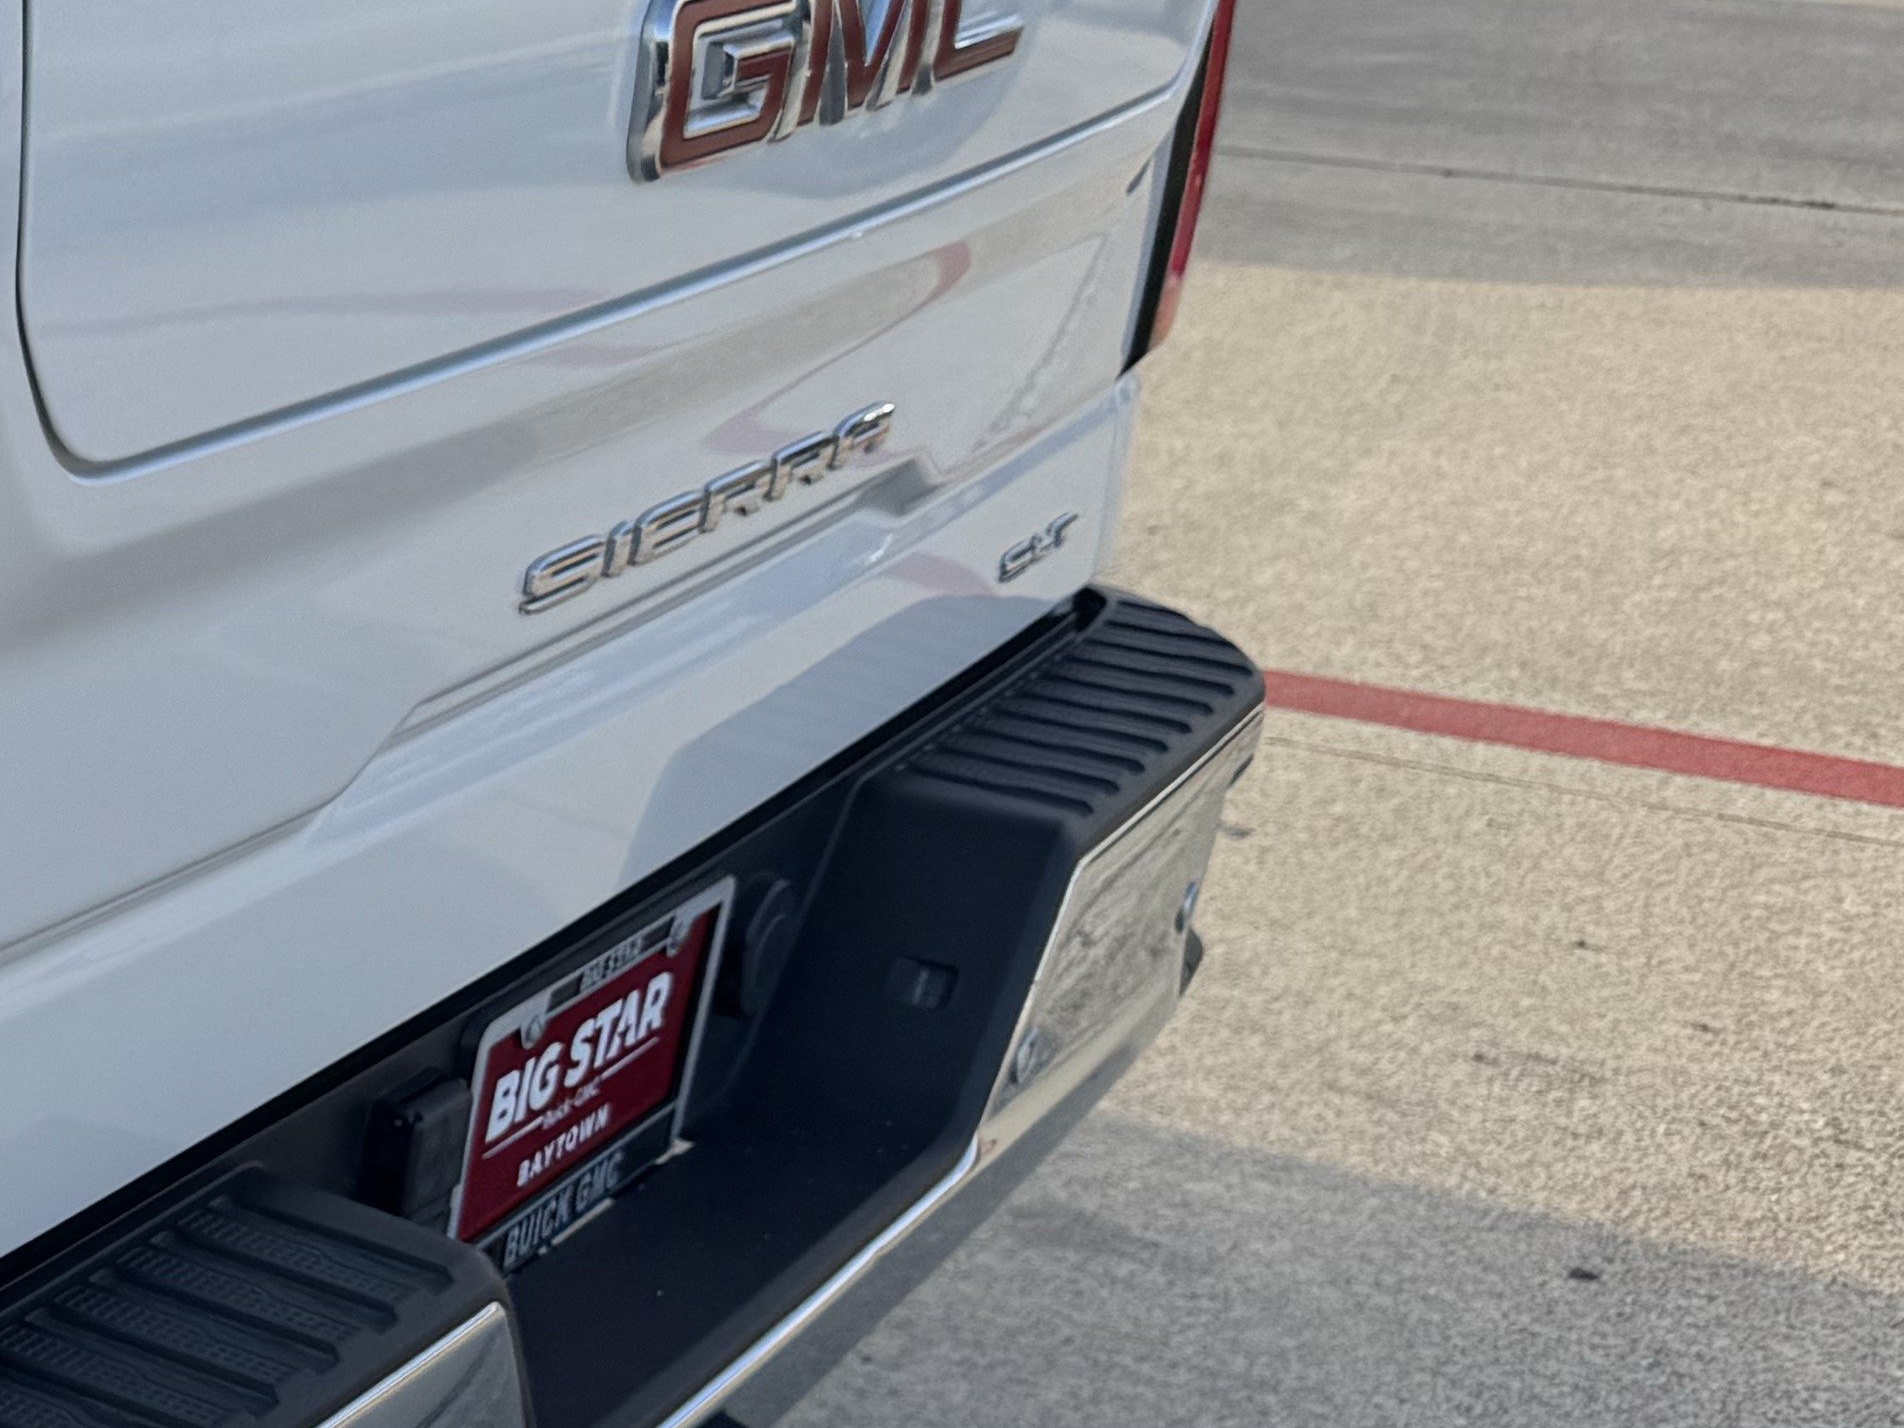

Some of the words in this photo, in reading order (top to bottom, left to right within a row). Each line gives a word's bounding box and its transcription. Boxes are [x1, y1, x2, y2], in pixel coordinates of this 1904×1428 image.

[517, 400, 896, 615] SIERRA
[486, 1041, 564, 1144] BIG
[565, 971, 673, 1088] STAR
[502, 1184, 574, 1272] BUICK
[575, 1149, 623, 1213] GMC
[517, 1102, 611, 1187] BAYTOWN
